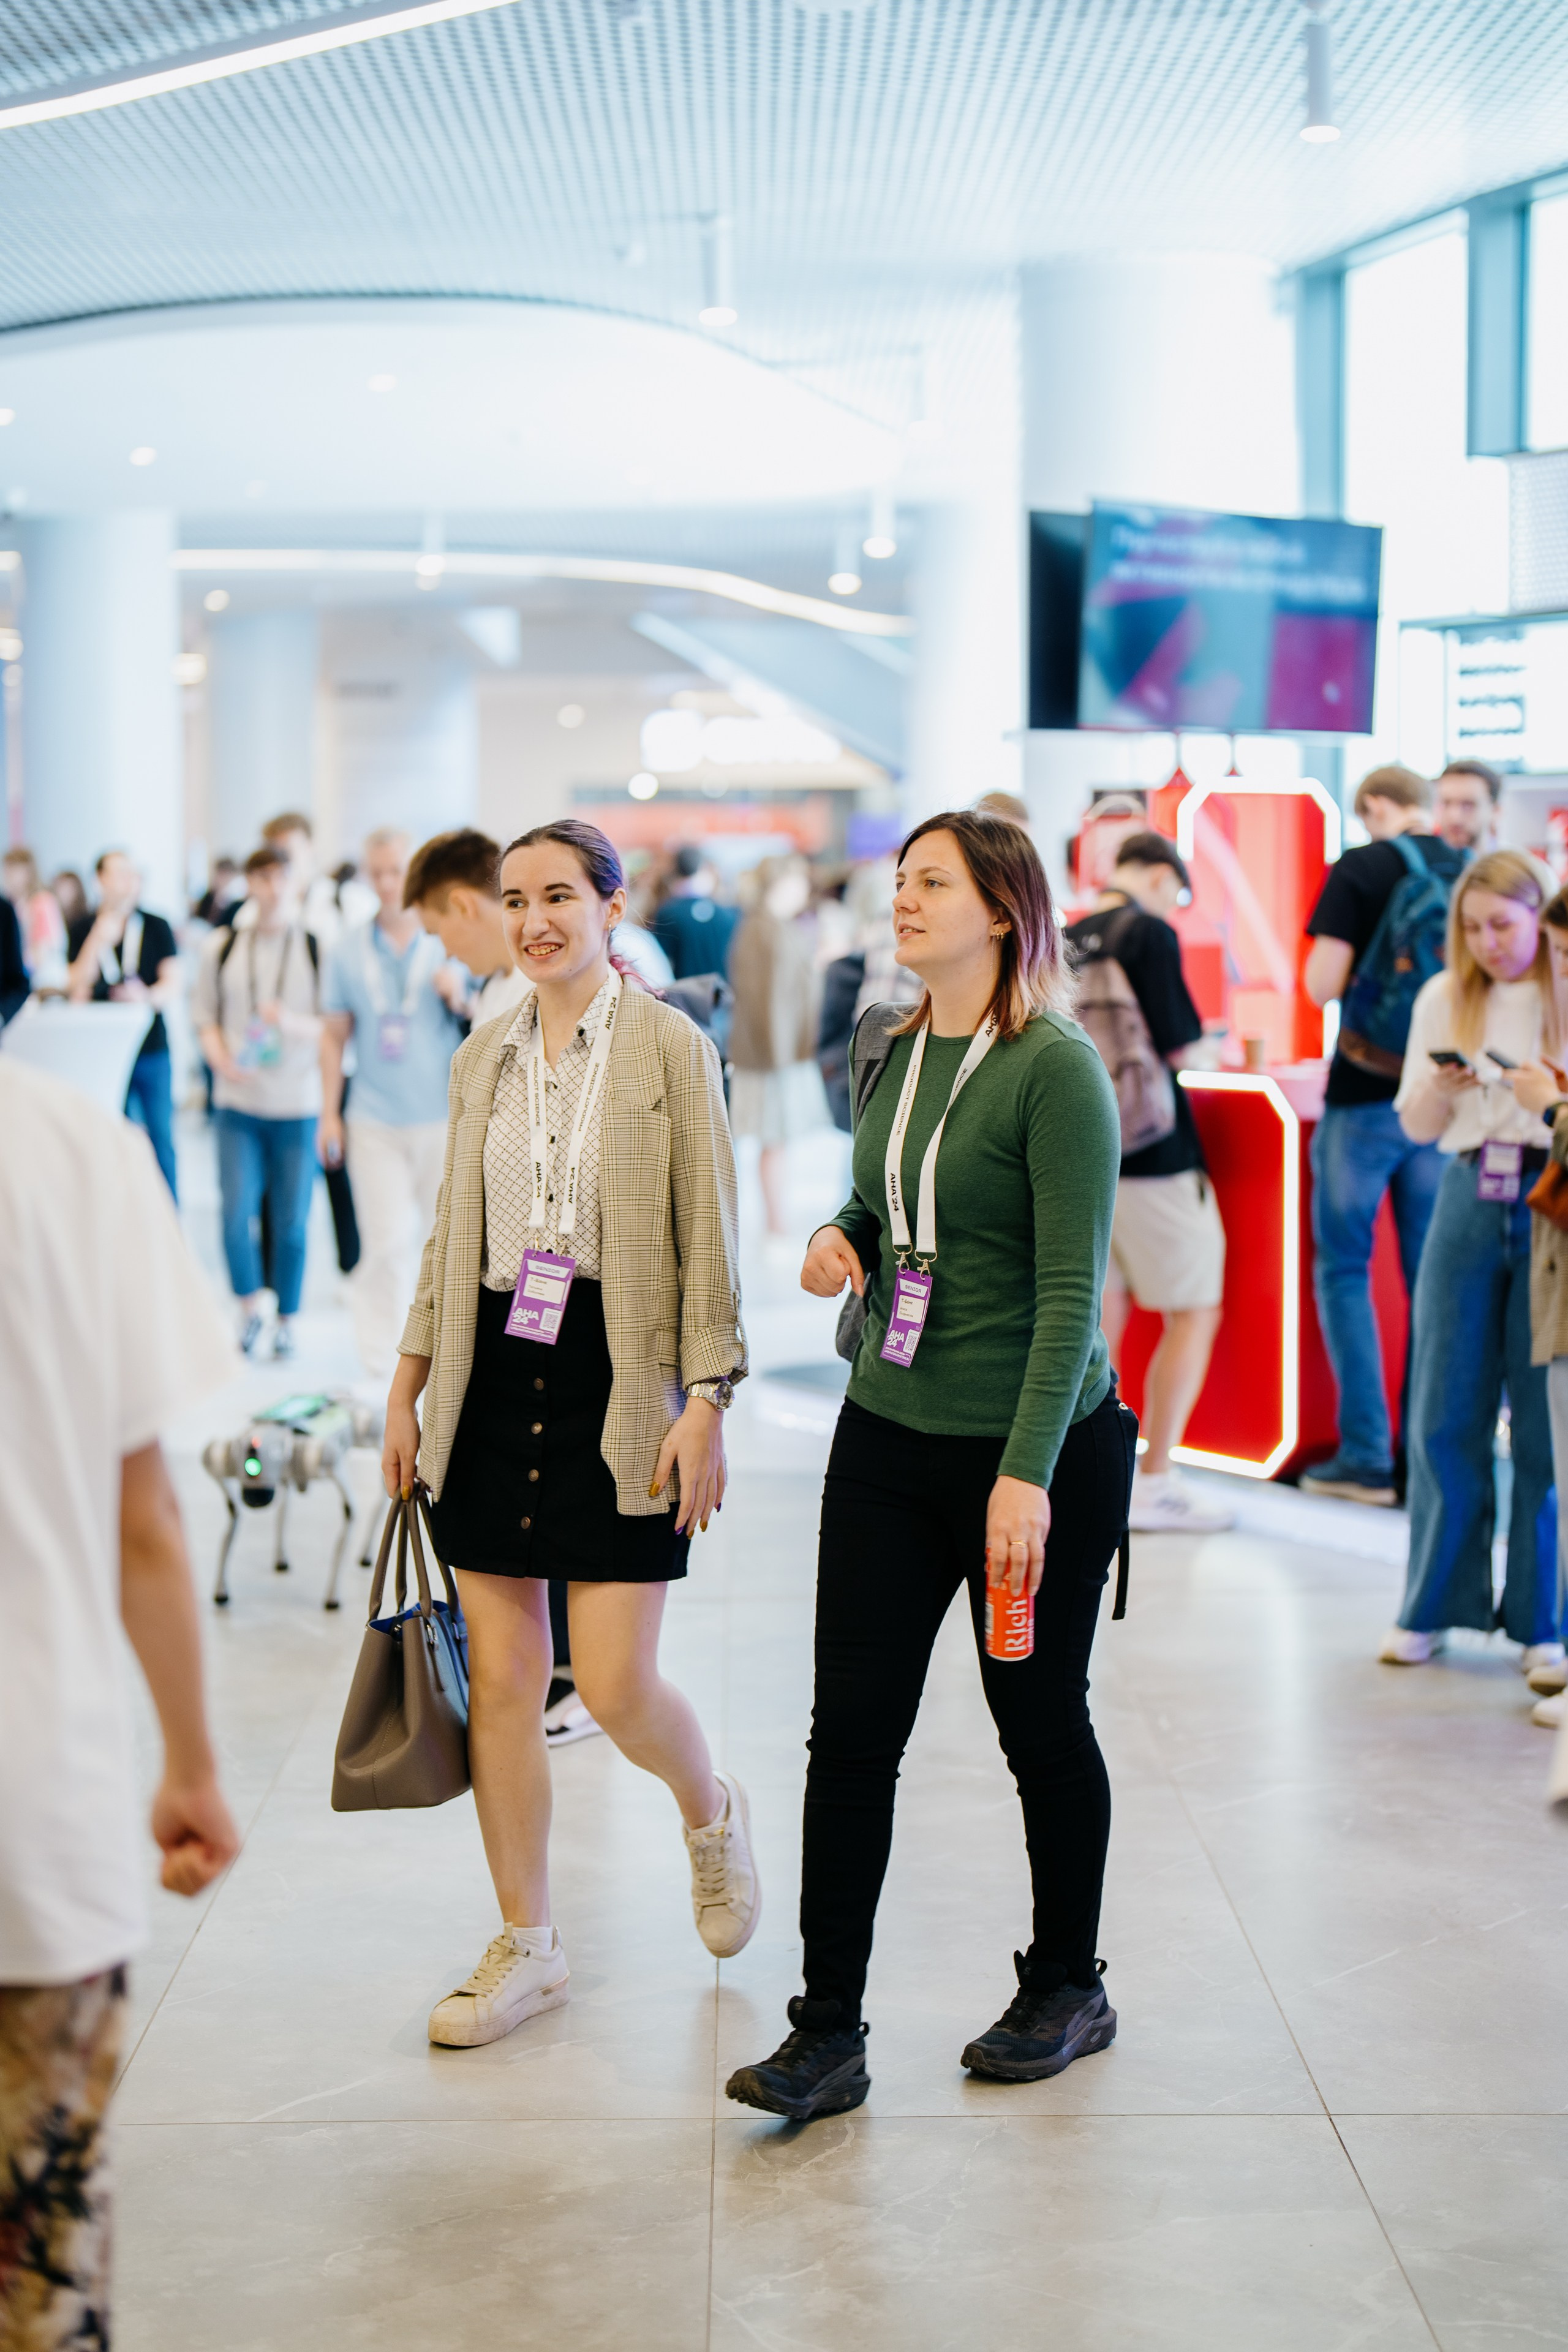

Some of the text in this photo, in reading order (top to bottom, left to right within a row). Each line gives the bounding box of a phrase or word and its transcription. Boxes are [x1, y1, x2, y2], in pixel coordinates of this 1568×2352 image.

[578, 1063, 600, 1132] PRODUCT SCIENCE
[896, 1065, 917, 1136] PRODUCT SCIENCE
[535, 1265, 560, 1275] SENIOR
[905, 1284, 922, 1294] SENIOR
[512, 1314, 529, 1325] 24
[514, 1307, 540, 1321] AHA
[886, 1336, 897, 1348] 24
[889, 1330, 905, 1343] AHA
